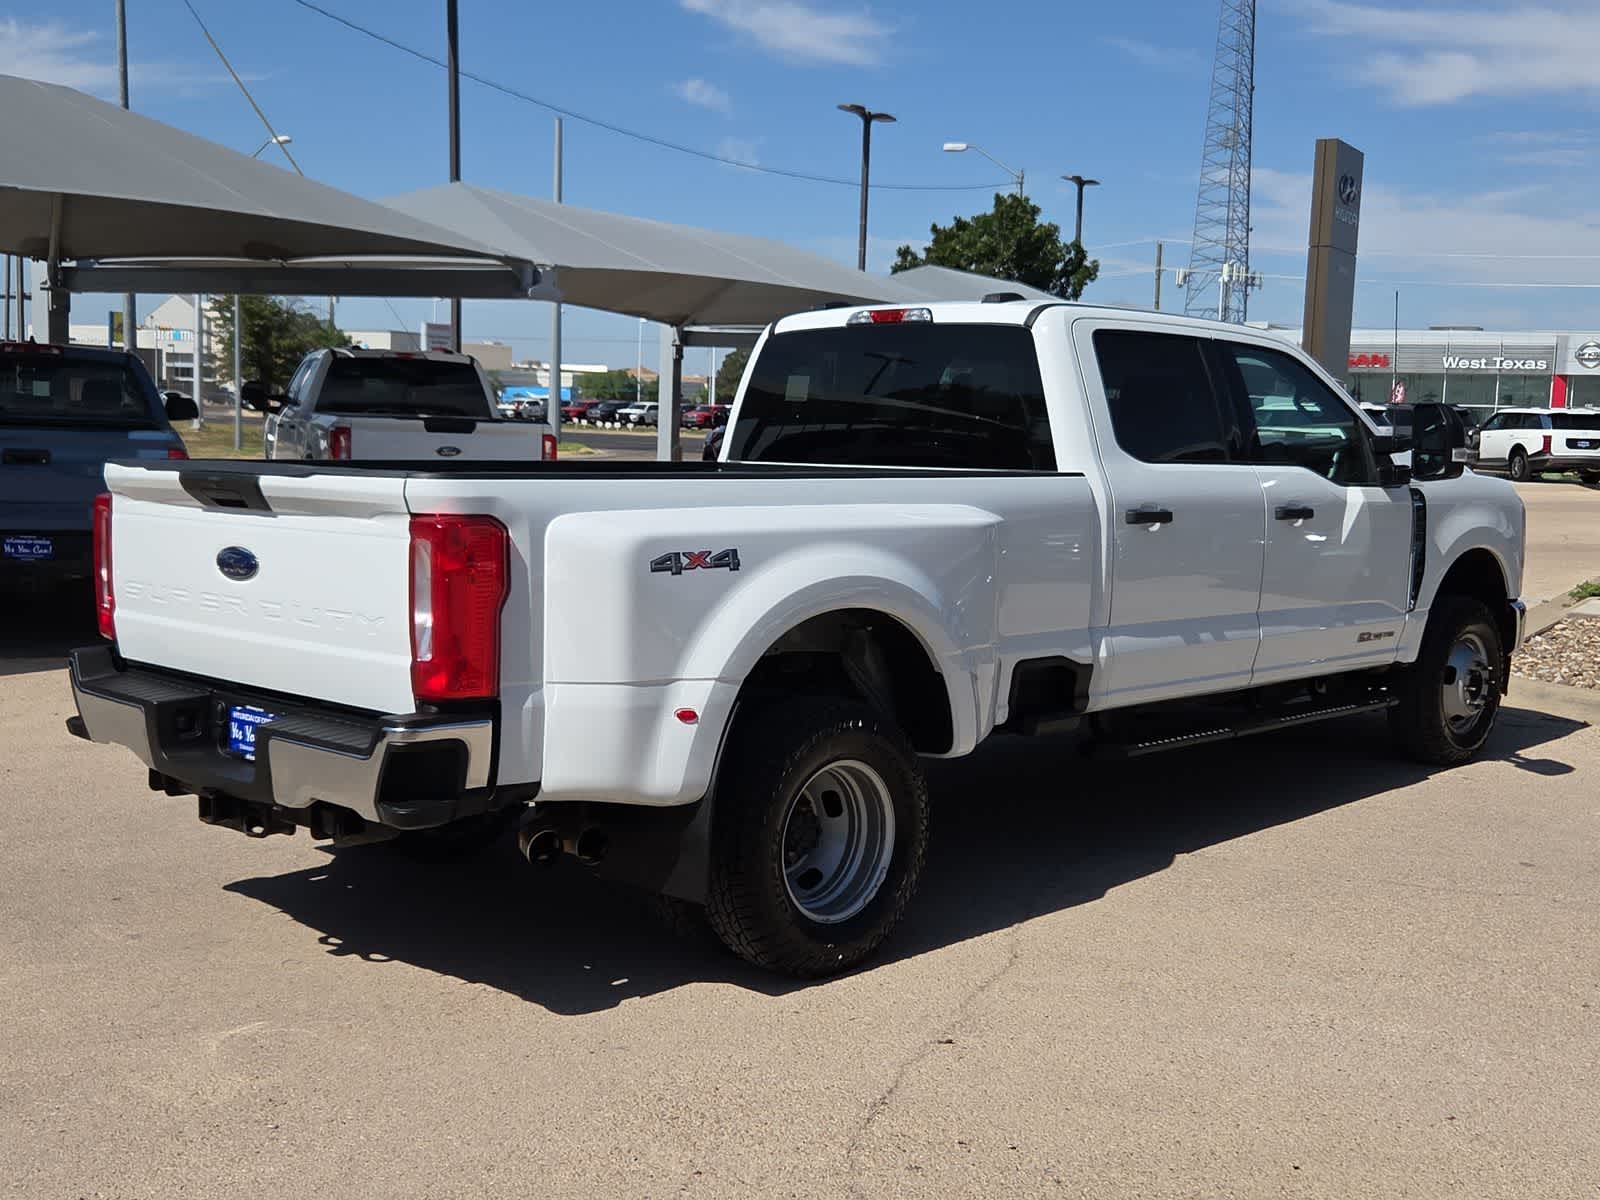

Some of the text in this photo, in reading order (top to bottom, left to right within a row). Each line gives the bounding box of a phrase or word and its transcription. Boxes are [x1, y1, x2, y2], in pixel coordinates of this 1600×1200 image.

[1442, 356, 1548, 370] West Texas
[125, 580, 386, 637] SUPER DUTY
[244, 724, 256, 742] Yo
